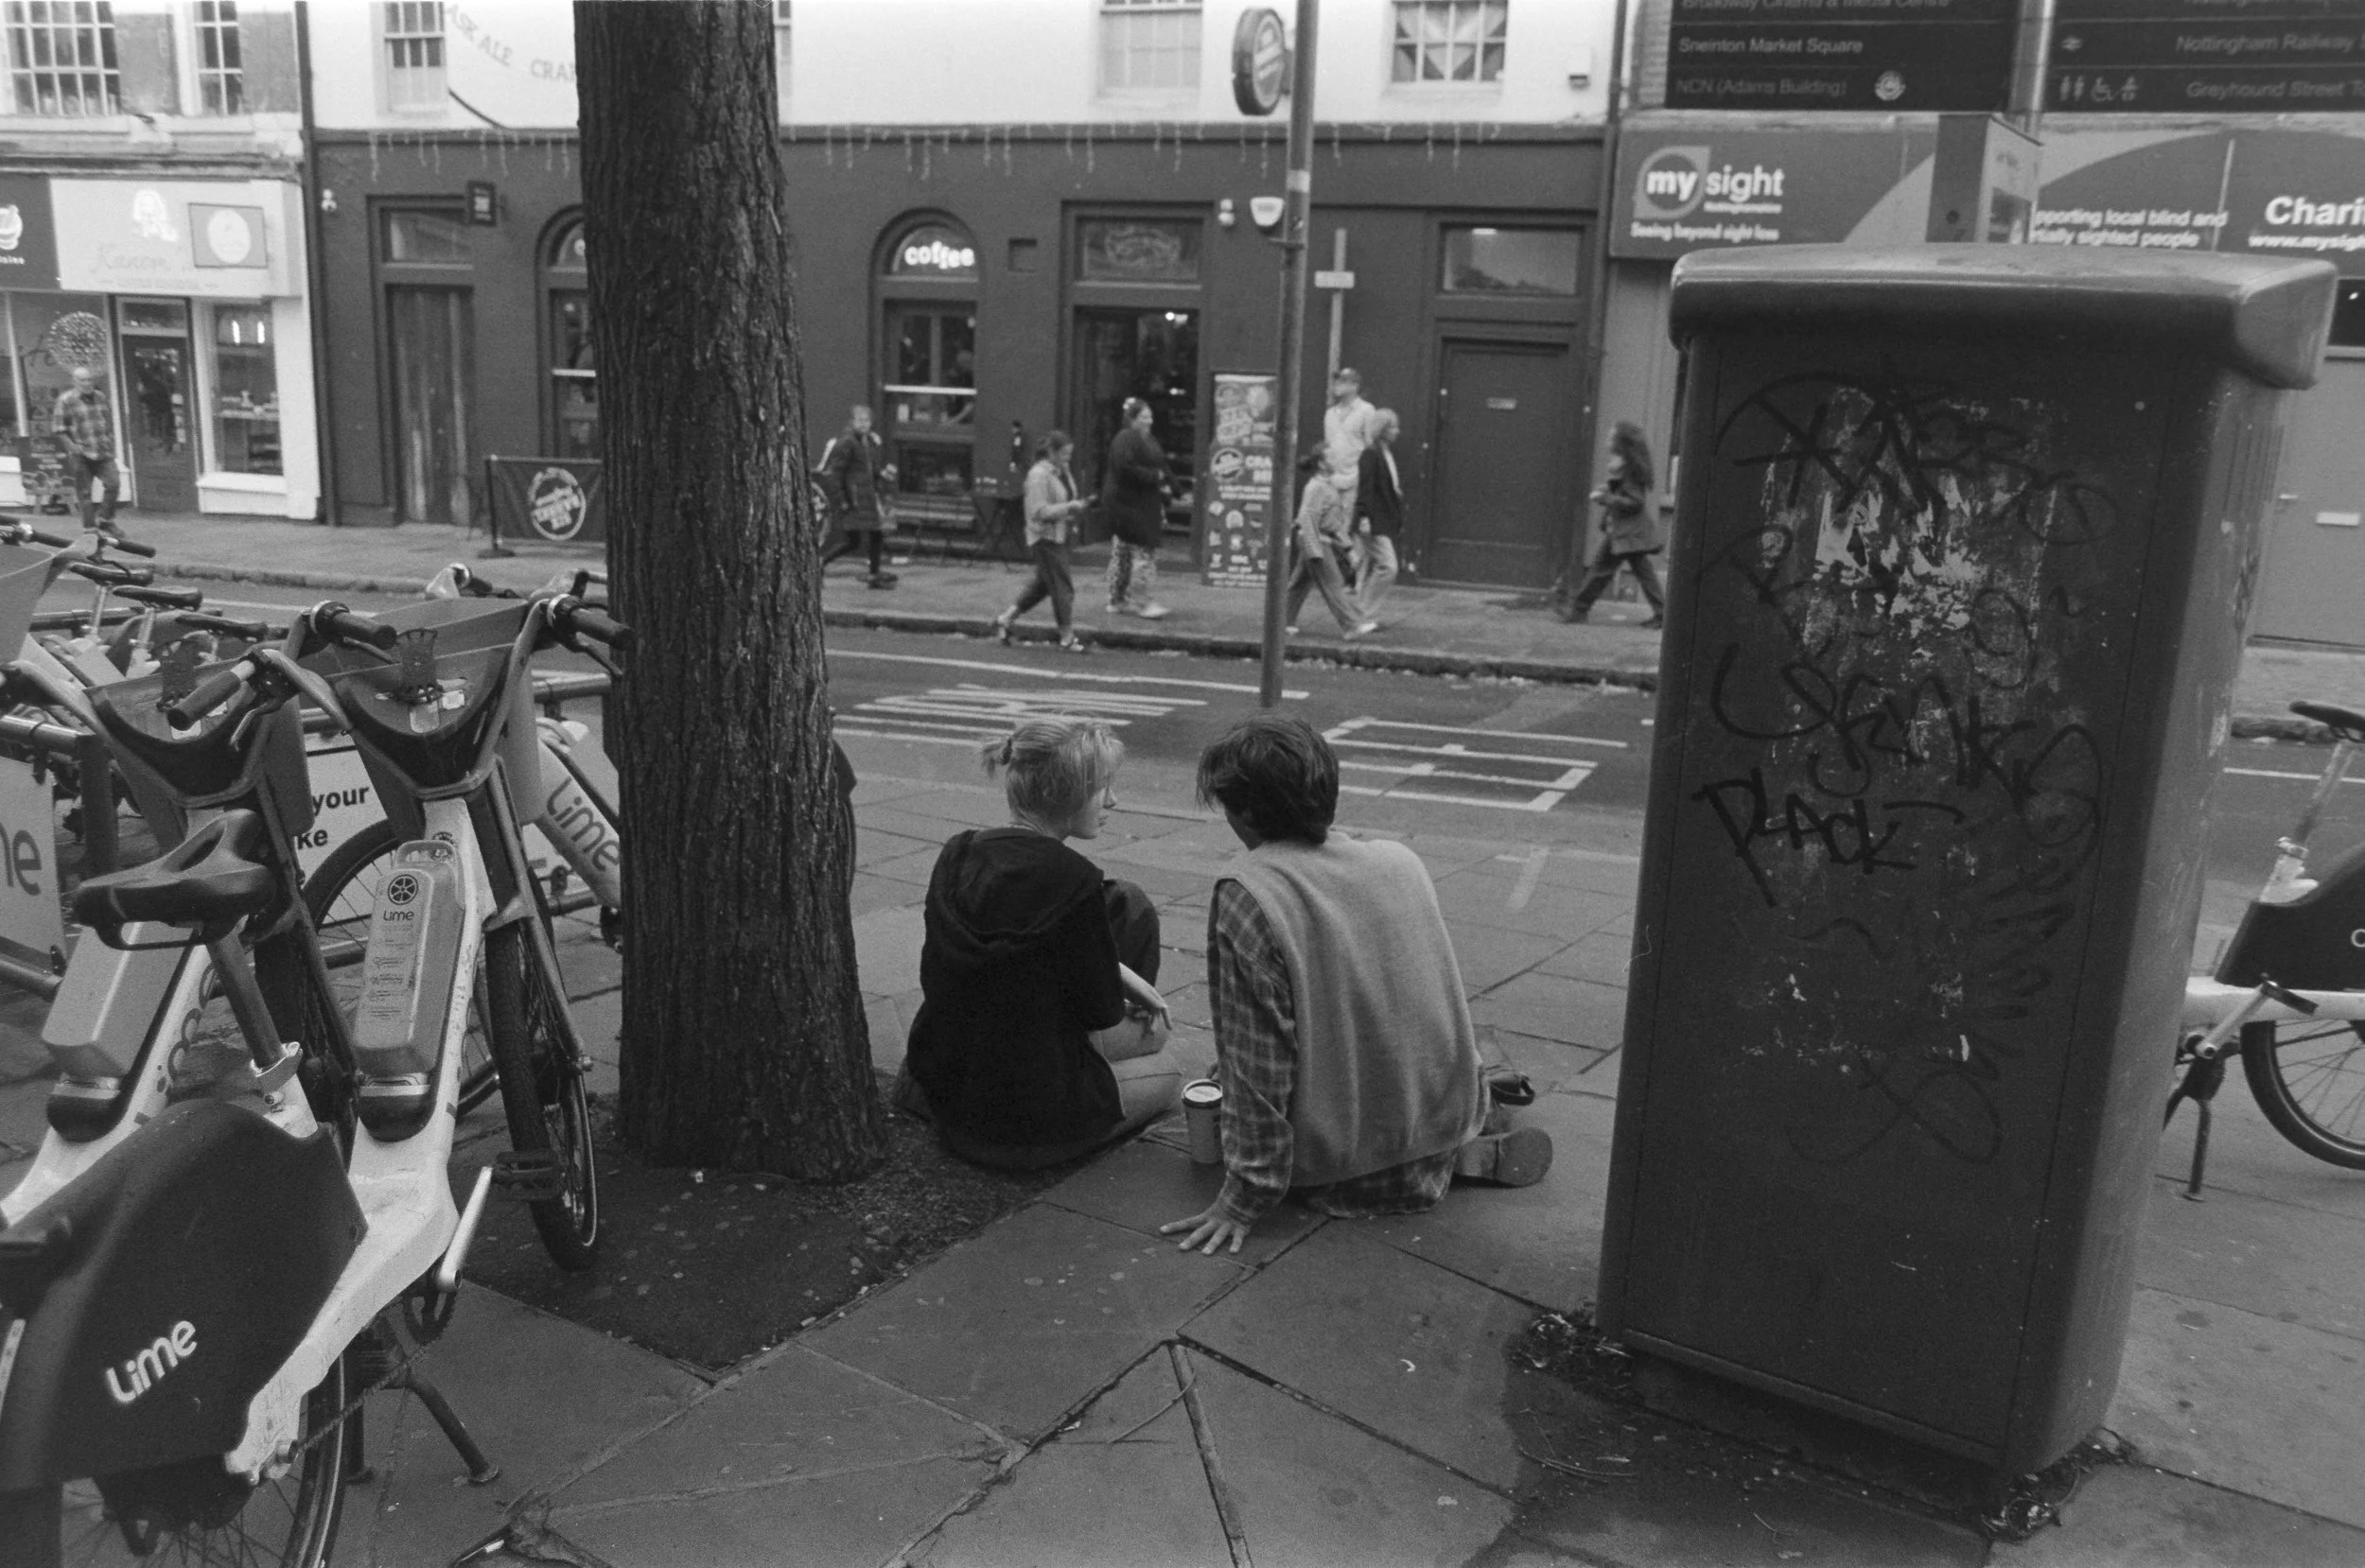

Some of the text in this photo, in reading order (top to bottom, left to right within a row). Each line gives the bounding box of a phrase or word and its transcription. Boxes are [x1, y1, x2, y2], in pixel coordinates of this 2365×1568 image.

[1678, 37, 1864, 56] Sneinton Market Square
[2177, 35, 2278, 55] Nottingham
[2282, 33, 2354, 53] Railway
[1675, 78, 1848, 97] NCN (Adams Building)
[2186, 80, 2286, 101] Greyhound
[2289, 80, 2346, 97] Street
[1646, 164, 1785, 202] my sight
[2104, 207, 2146, 227] local
[2146, 207, 2191, 227] blind
[2192, 210, 2228, 227] and
[2264, 195, 2365, 225] Chari
[1723, 221, 1753, 244] sight
[2076, 229, 2139, 246] sighted
[2140, 231, 2199, 248] people
[904, 239, 975, 270] coffee
[313, 786, 370, 816] your
